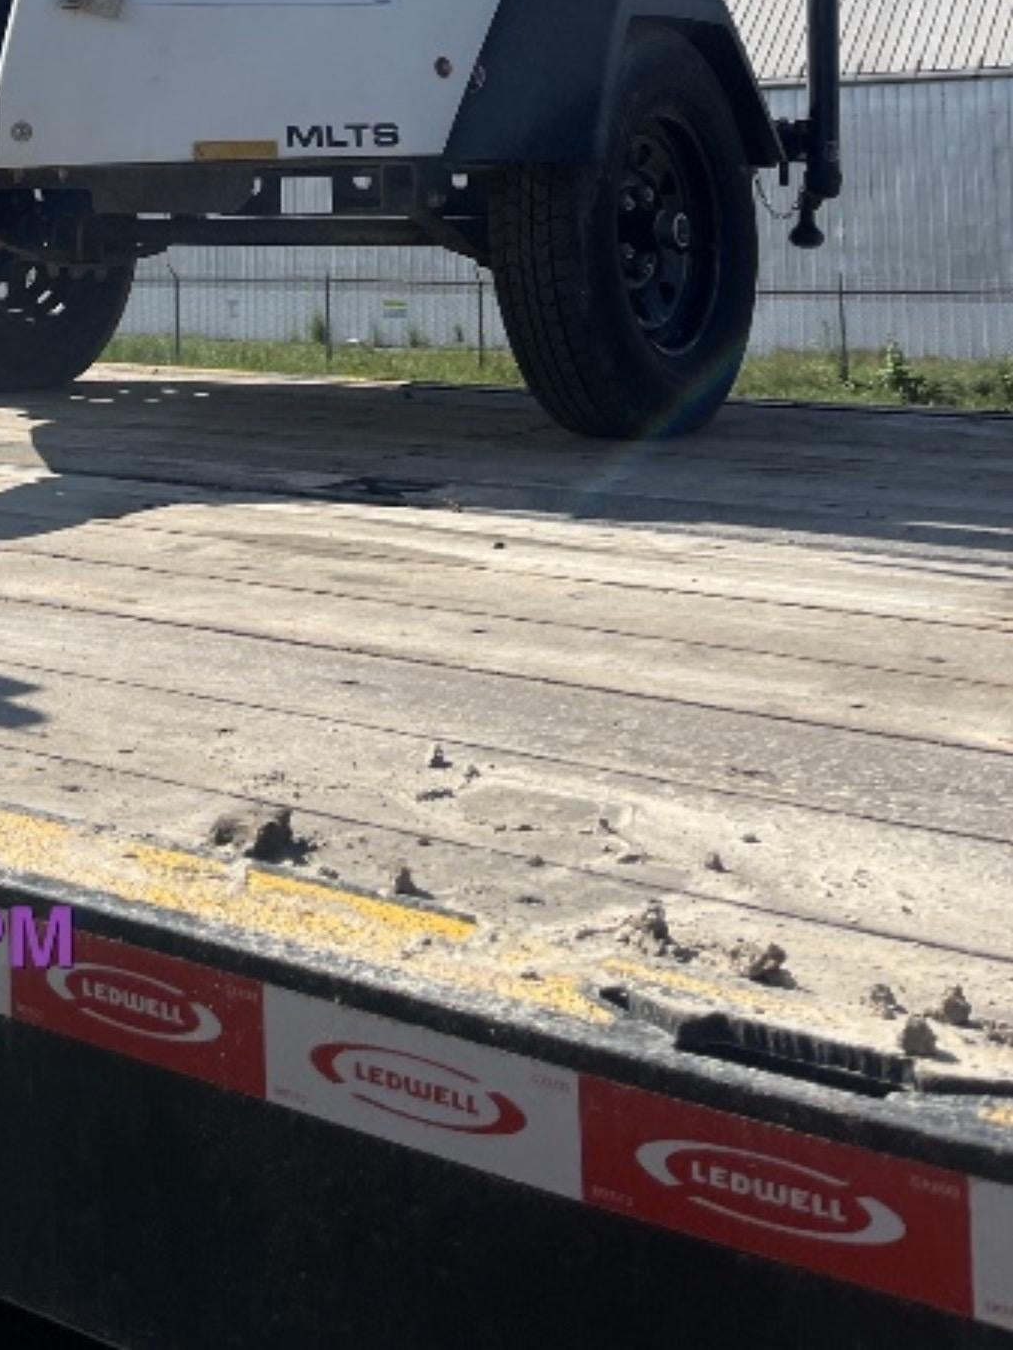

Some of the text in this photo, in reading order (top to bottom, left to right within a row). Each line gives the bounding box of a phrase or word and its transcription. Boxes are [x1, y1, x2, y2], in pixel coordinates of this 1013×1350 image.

[285, 122, 400, 149] MLTS
[81, 976, 186, 1026] LEDWELL
[353, 1060, 481, 1117] LEDWELL
[690, 1159, 848, 1224] LEDWELL
